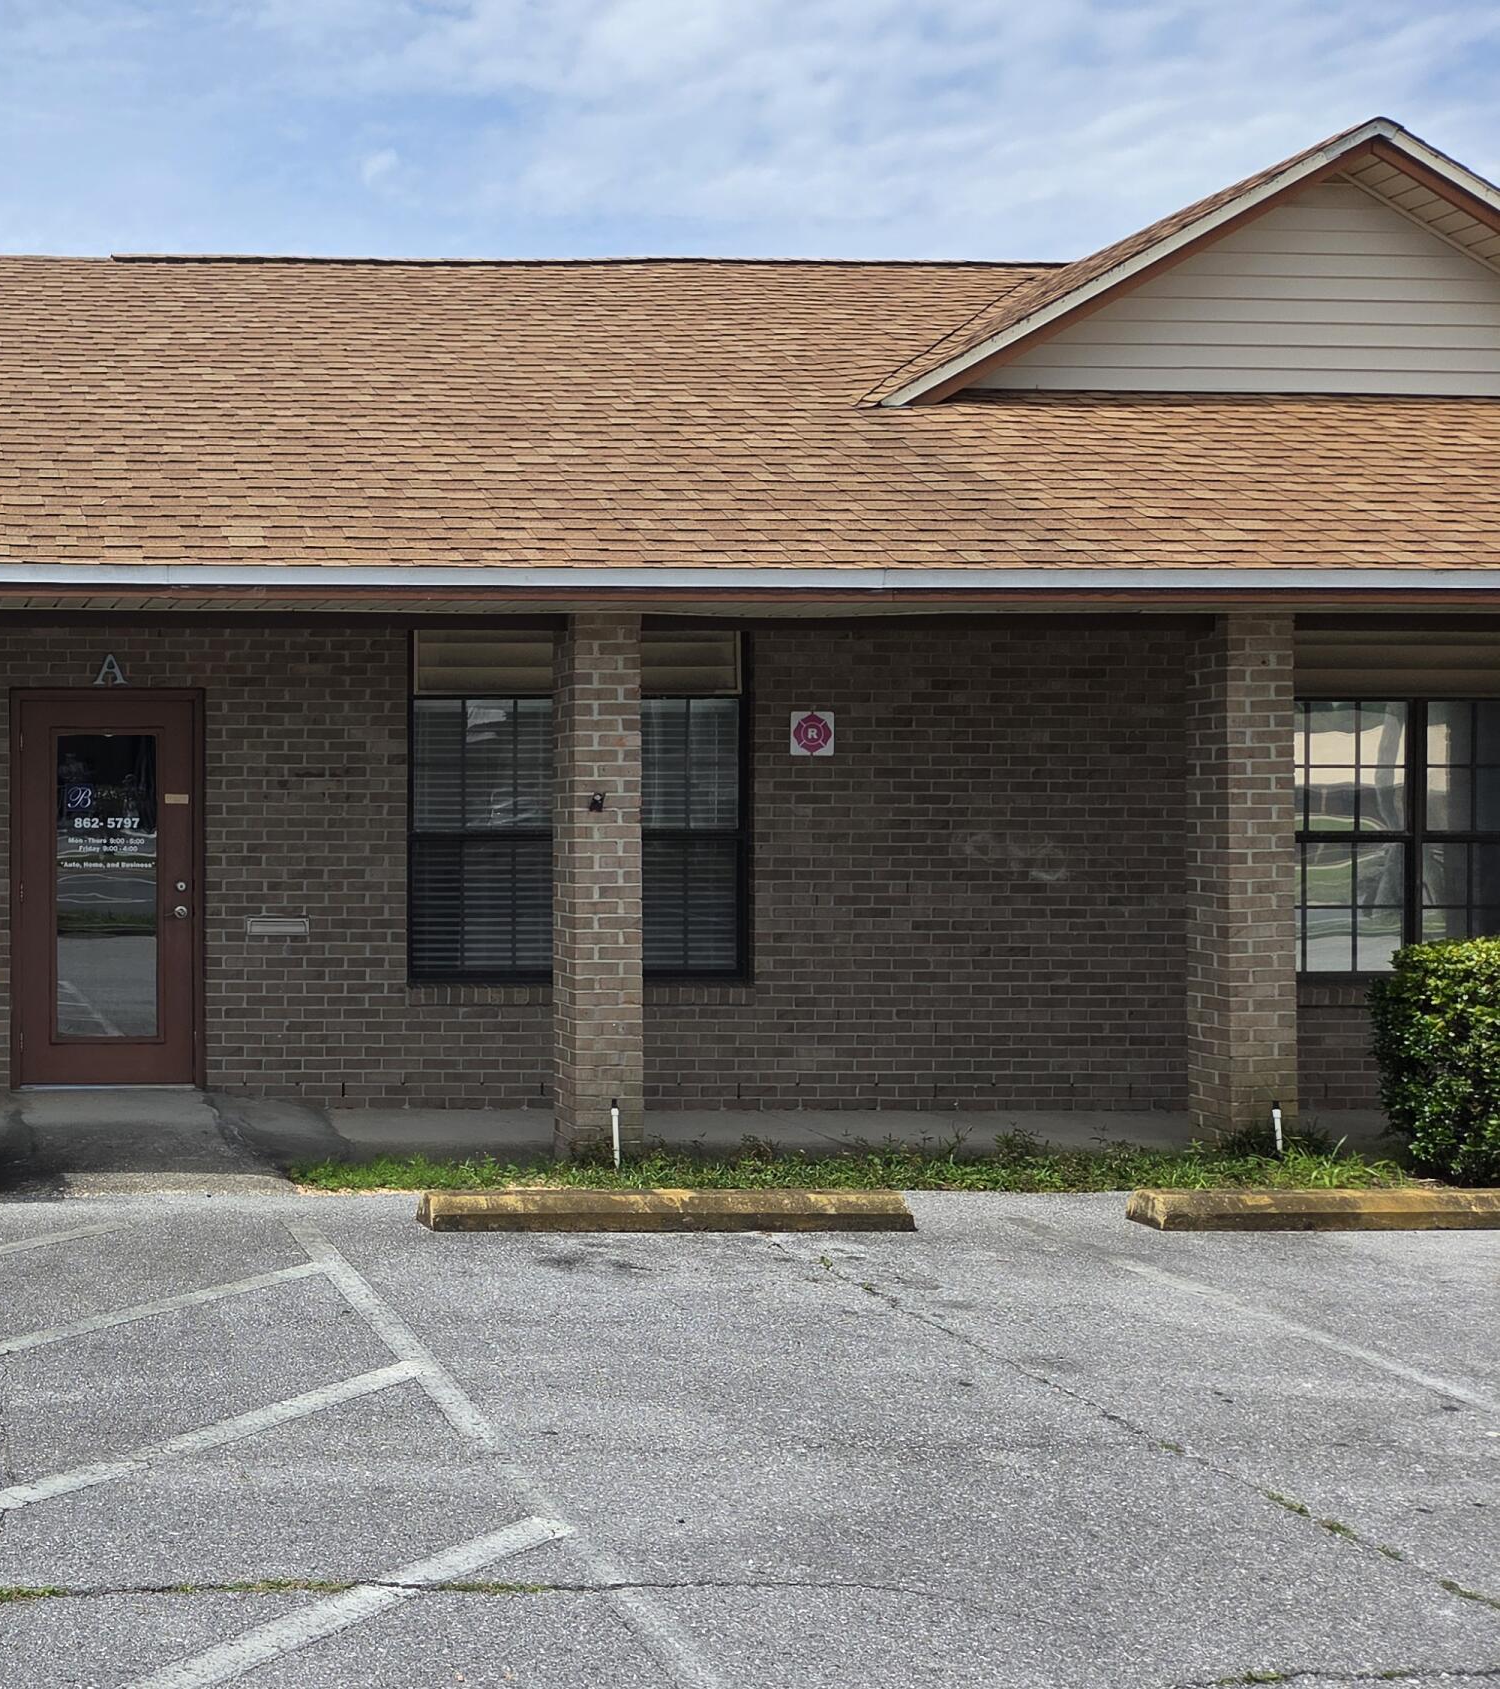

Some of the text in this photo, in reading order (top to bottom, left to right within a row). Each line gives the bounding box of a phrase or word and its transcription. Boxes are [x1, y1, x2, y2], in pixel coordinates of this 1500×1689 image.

[93, 654, 129, 685] A
[808, 728, 818, 739] R
[107, 817, 140, 829] 5797
[79, 845, 100, 853] Friday
